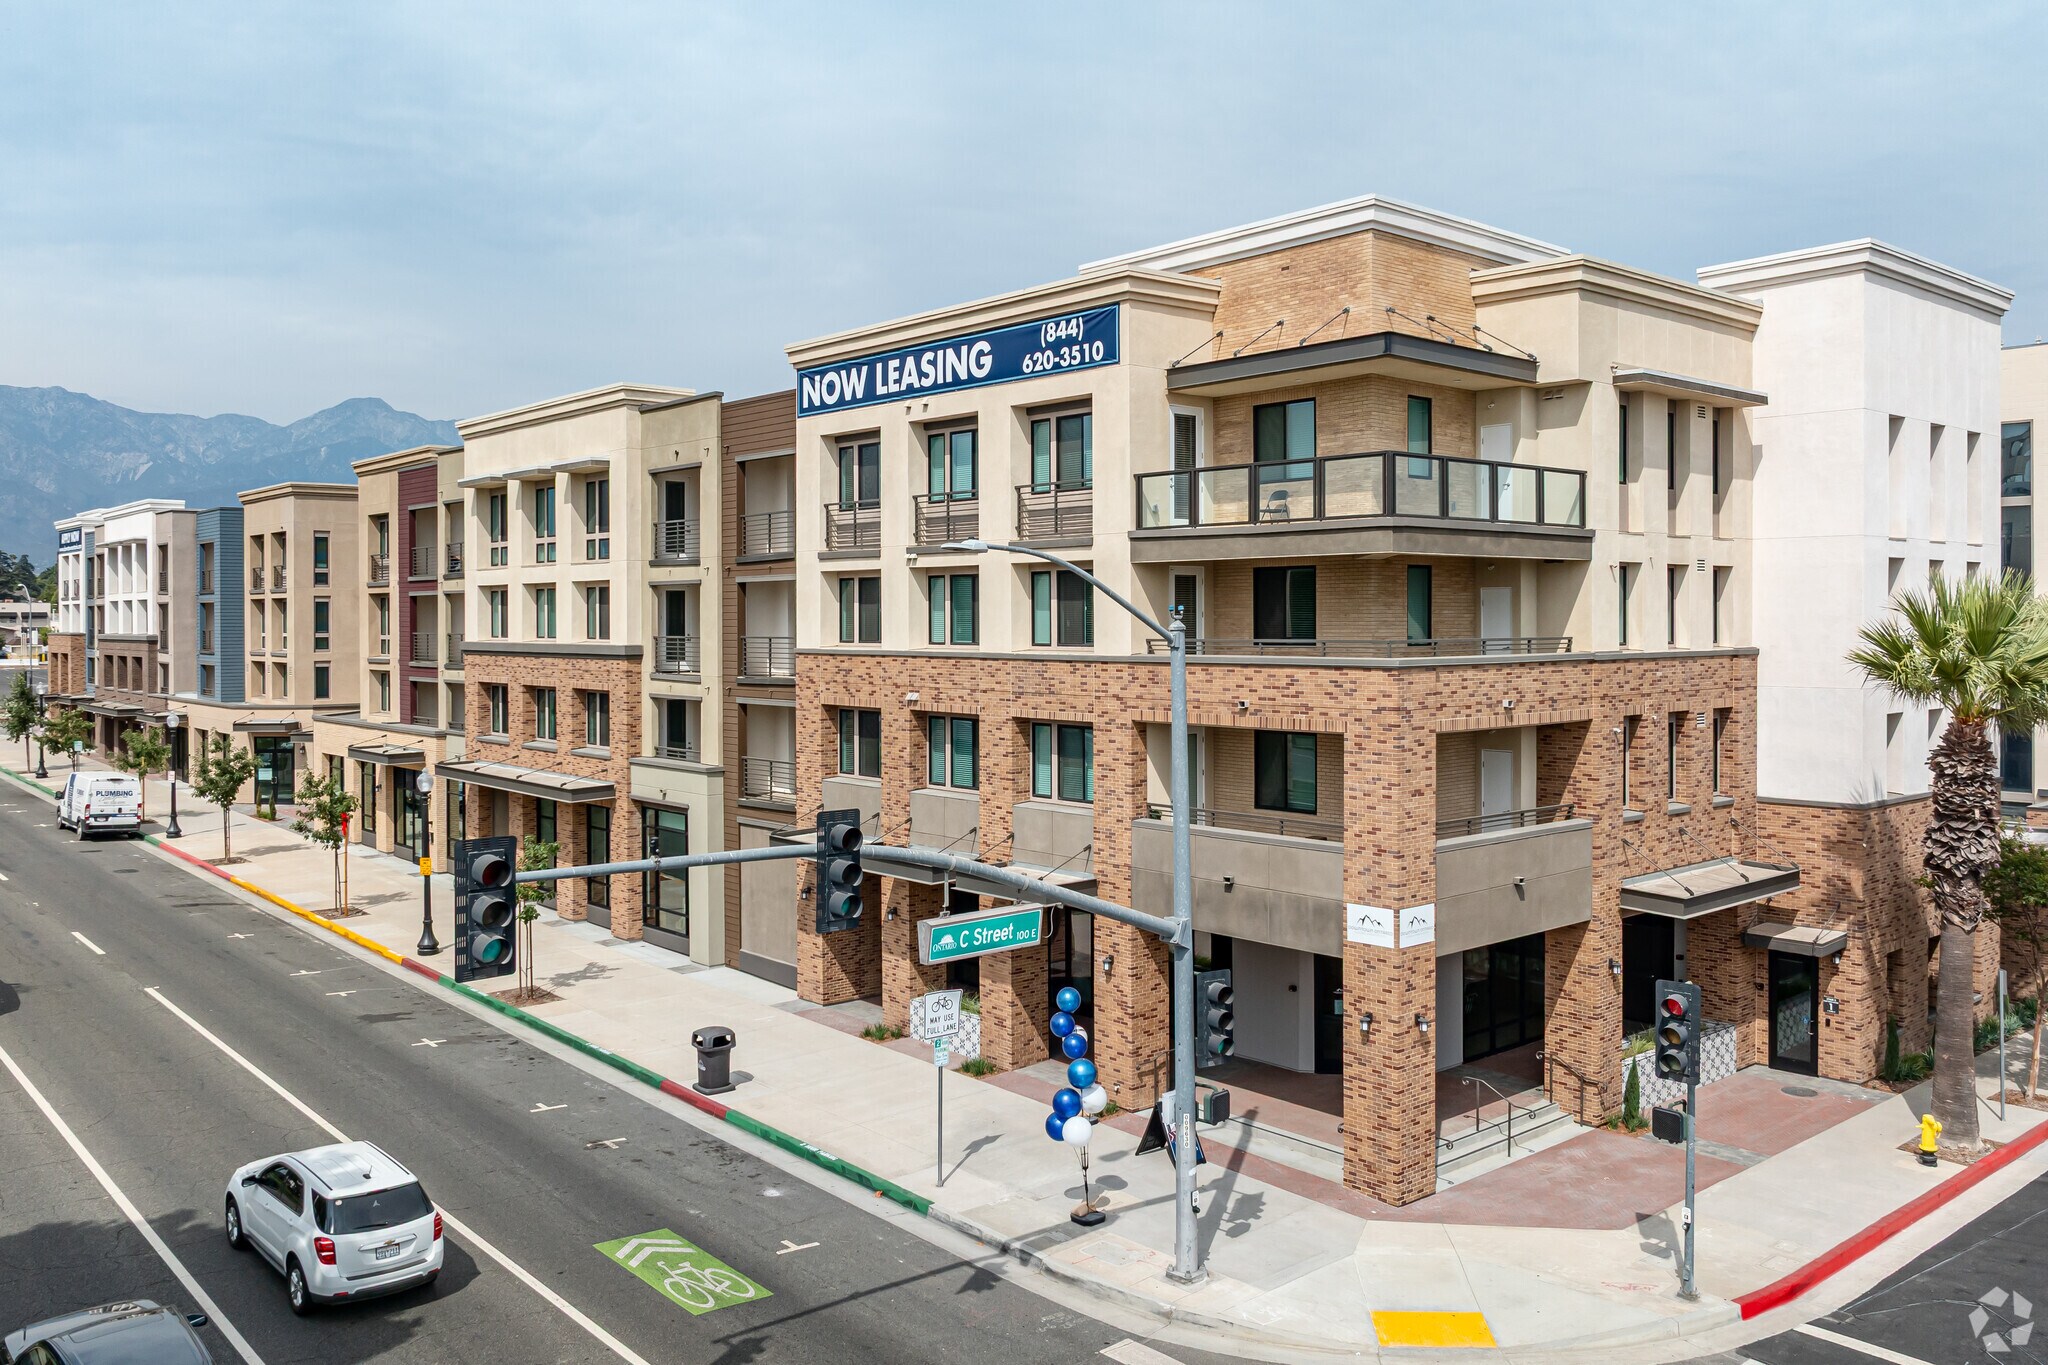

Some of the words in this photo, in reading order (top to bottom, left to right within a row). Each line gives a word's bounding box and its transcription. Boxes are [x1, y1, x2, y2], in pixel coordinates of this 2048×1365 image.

[1041, 316, 1084, 347] (844)
[1022, 340, 1104, 374] 620-3510
[802, 365, 868, 408] NOW
[875, 340, 993, 395] LEASING
[959, 930, 970, 948] C
[973, 922, 1014, 946] Street
[1016, 930, 1030, 940] 100
[1031, 928, 1037, 938] E
[932, 942, 957, 952] ONTARIO
[930, 1016, 941, 1024] MAY
[944, 1013, 954, 1021] USE
[927, 1027, 940, 1035] FULL
[943, 1023, 957, 1032] LANE
[936, 1039, 941, 1047] 2
